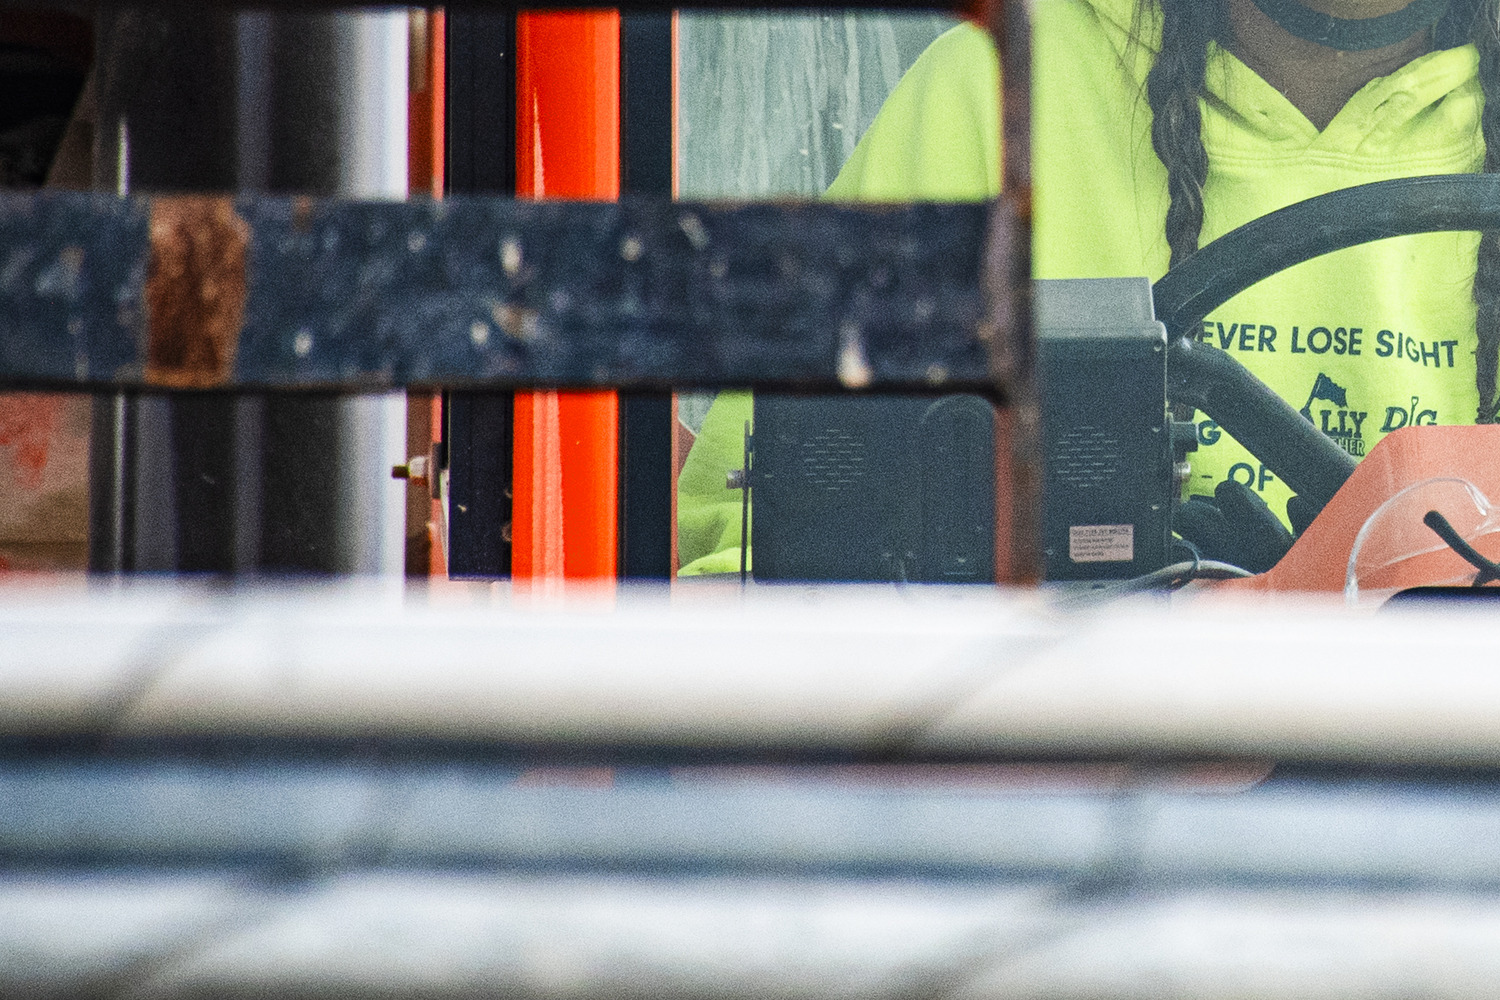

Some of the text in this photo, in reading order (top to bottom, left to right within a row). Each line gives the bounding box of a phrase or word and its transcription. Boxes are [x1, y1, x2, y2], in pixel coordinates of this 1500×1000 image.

[1203, 321, 1459, 368] EVER LOSE SIGHT
[1228, 463, 1274, 491] OF
